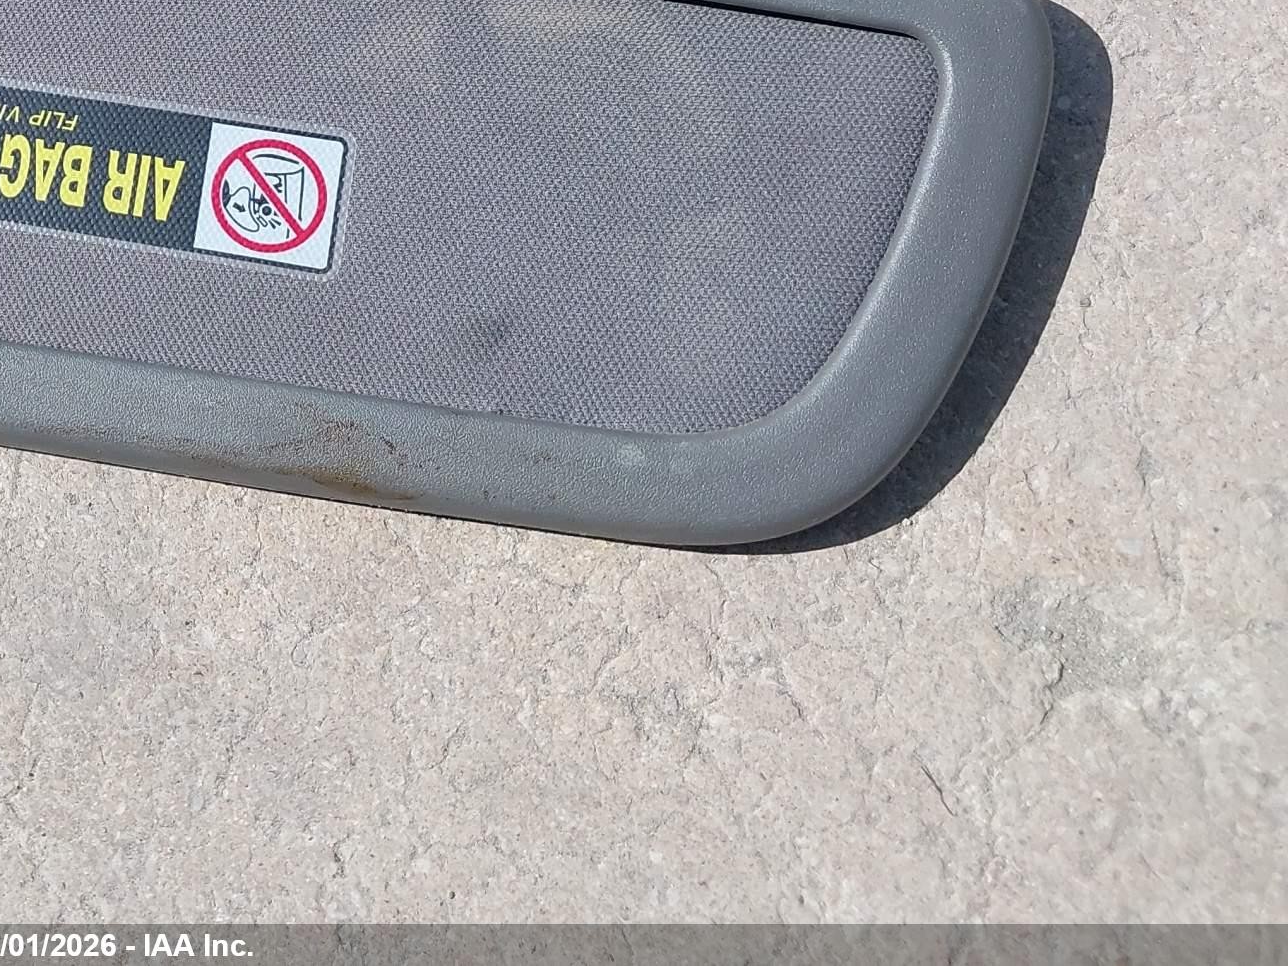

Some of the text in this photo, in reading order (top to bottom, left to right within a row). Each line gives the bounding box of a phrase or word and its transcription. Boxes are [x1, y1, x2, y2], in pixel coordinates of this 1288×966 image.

[29, 110, 79, 132] FLIP
[0, 133, 94, 208] BAG
[104, 150, 186, 222] AIR
